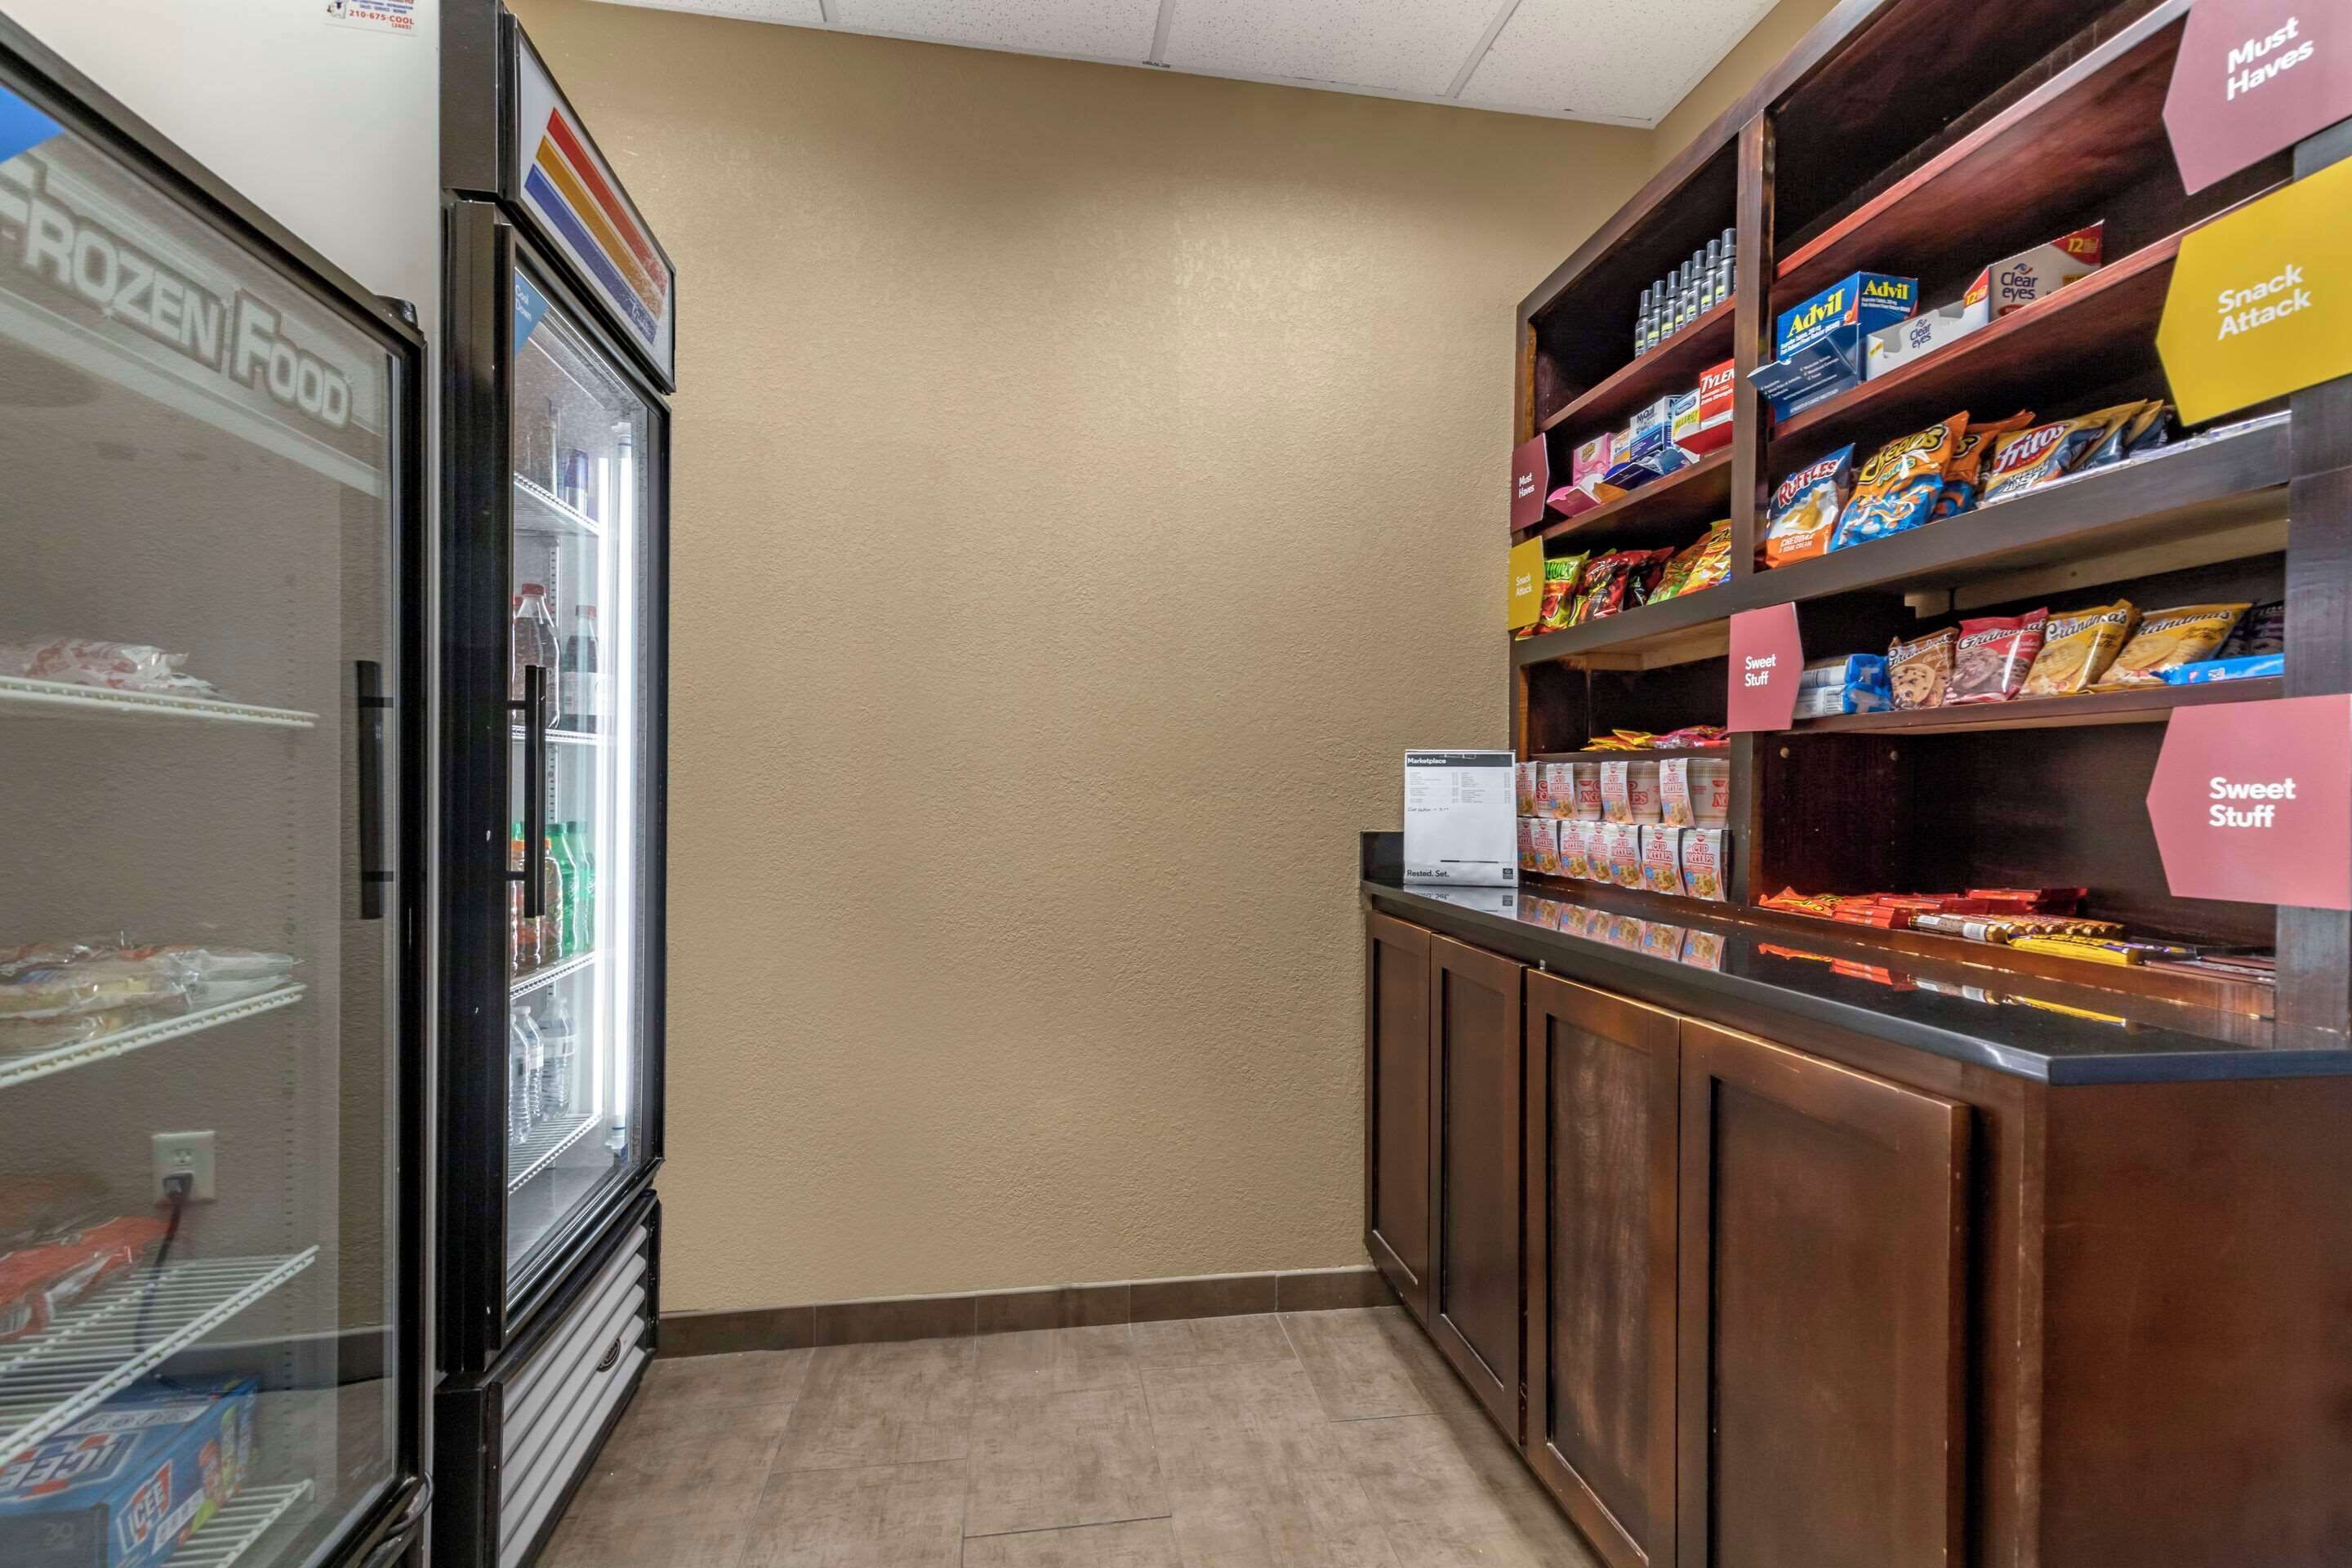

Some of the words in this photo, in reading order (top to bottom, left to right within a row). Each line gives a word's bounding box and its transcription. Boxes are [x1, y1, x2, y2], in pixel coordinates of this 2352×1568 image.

[2228, 16, 2300, 74] Must
[2226, 40, 2314, 101] Haves
[2068, 238, 2083, 252] 12
[1862, 279, 1909, 300] Advil
[2001, 272, 2038, 287] Clear
[2217, 264, 2305, 314] Snack
[2002, 287, 2036, 302] eyes
[1786, 288, 1844, 338] Advil
[2217, 288, 2312, 341] Attack
[1910, 323, 1931, 341] Clear
[1912, 332, 1931, 349] eyes
[1993, 425, 2068, 474] Fritos
[1519, 472, 1532, 487] Must
[1779, 460, 1838, 507] RUFFLES
[1519, 484, 1535, 498] Haves
[2140, 611, 2230, 636] randma's
[1745, 654, 1776, 670] Sweet
[1744, 670, 1769, 687] Stuff
[2208, 777, 2296, 800] Sweet
[2208, 804, 2276, 827] Stuff
